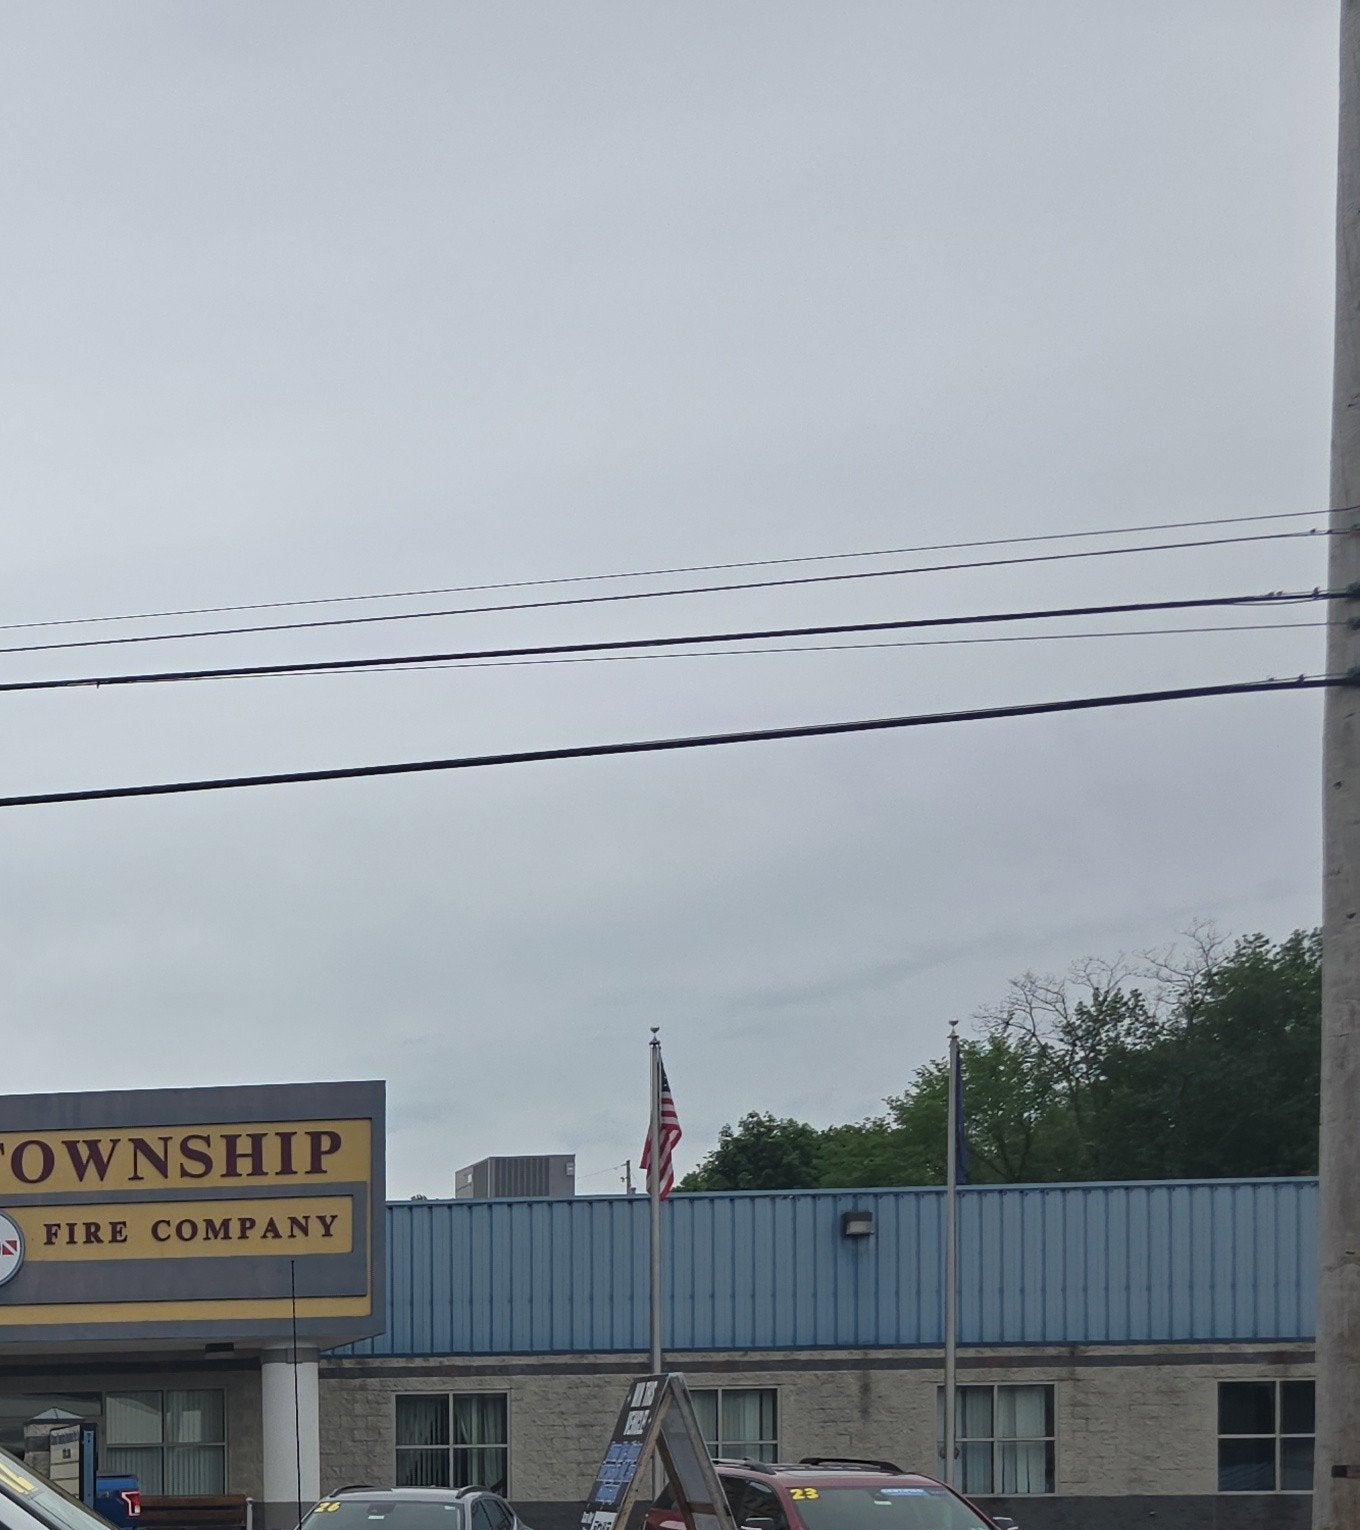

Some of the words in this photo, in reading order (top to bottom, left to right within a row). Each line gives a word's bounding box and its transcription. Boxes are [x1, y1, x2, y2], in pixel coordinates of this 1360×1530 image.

[43, 1220, 129, 1246] FIRE
[150, 1214, 339, 1243] COMPANY
[789, 1487, 820, 1500] 23
[313, 1501, 342, 1513] 26
